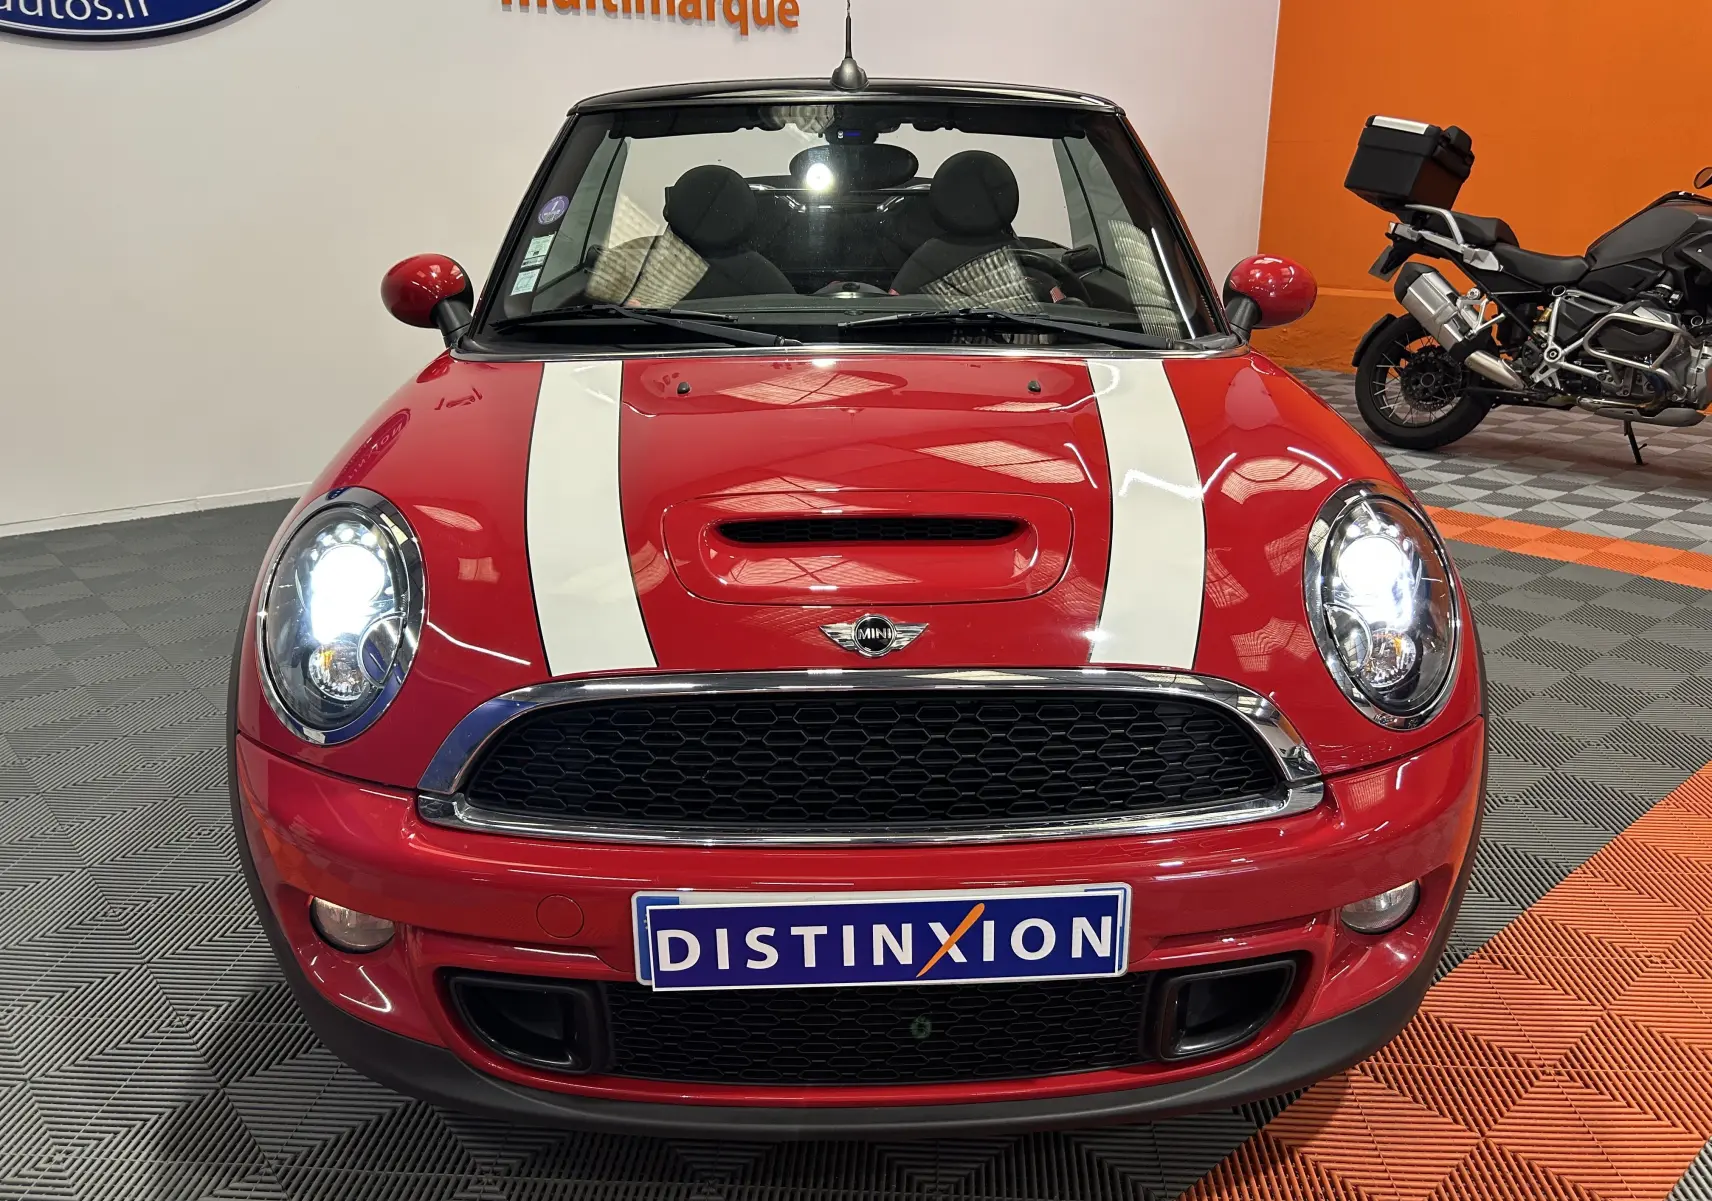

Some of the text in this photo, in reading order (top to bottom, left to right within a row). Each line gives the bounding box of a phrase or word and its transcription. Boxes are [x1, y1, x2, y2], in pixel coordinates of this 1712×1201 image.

[502, 0, 800, 36] marque
[858, 627, 892, 640] MINI
[656, 903, 1112, 977] DISTINXION
